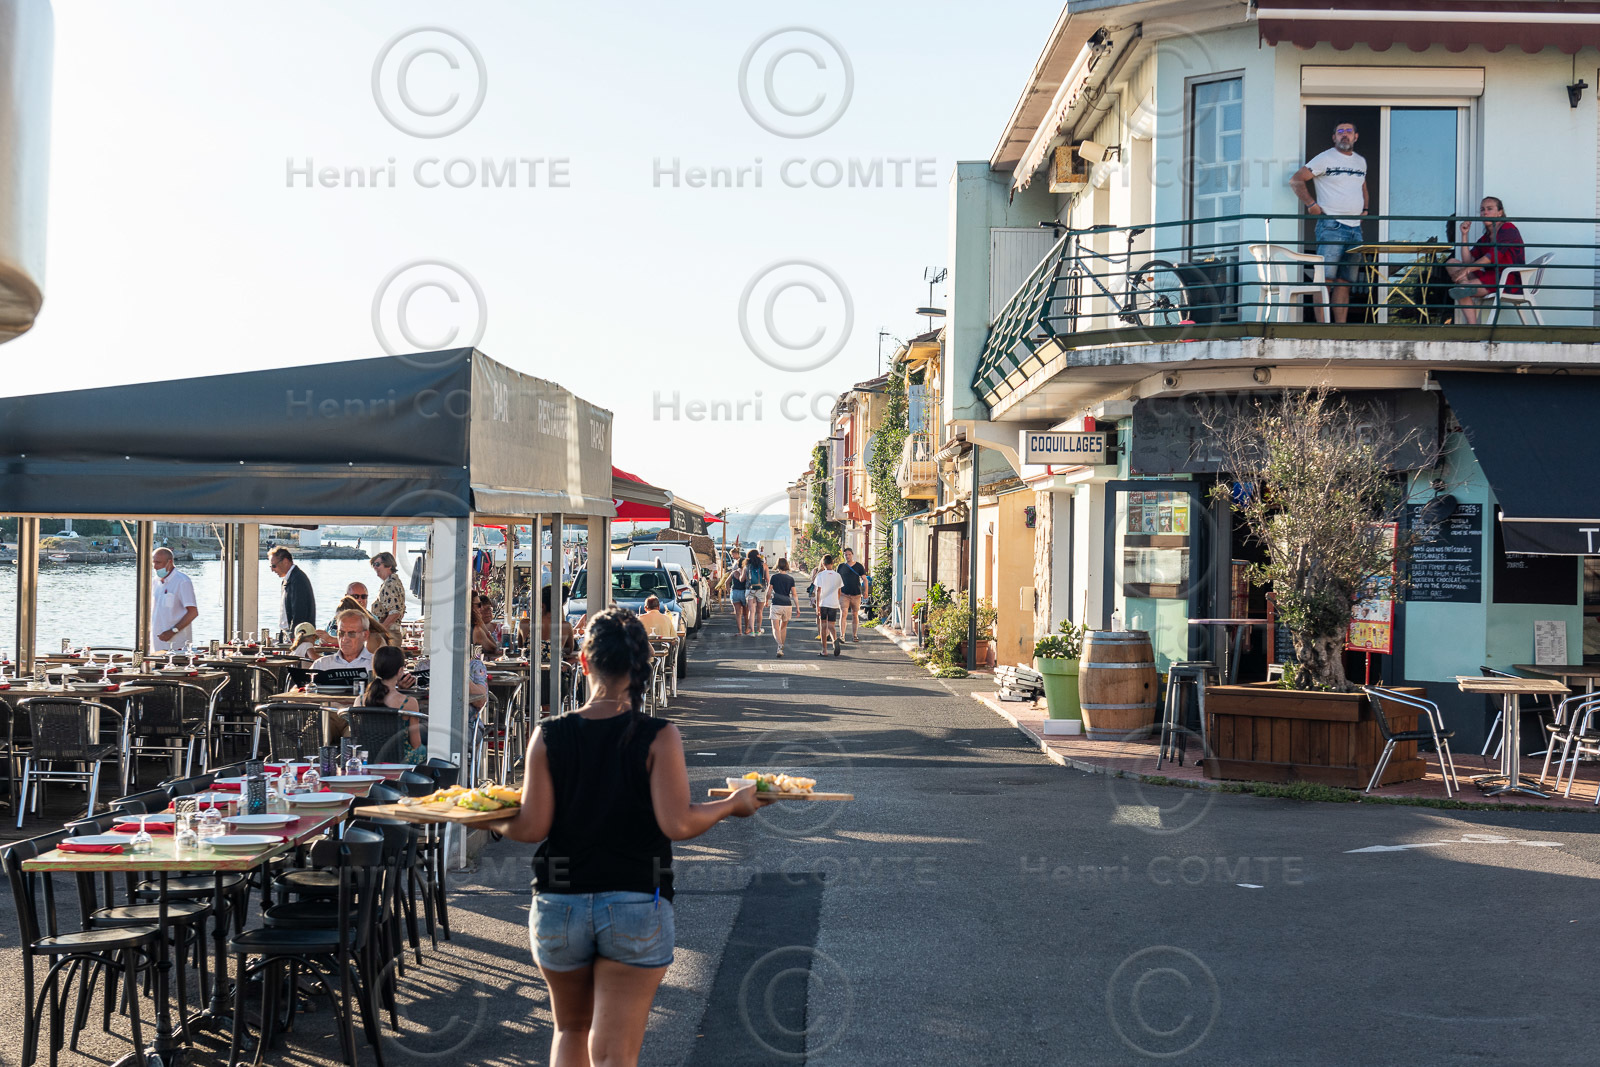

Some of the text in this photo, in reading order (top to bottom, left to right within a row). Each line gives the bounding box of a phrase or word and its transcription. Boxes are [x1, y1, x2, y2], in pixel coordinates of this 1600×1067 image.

[493, 380, 509, 424] BAR
[589, 419, 605, 452] TAPAS
[1031, 436, 1102, 453] COQUILLAGES
[1578, 527, 1600, 553] T
